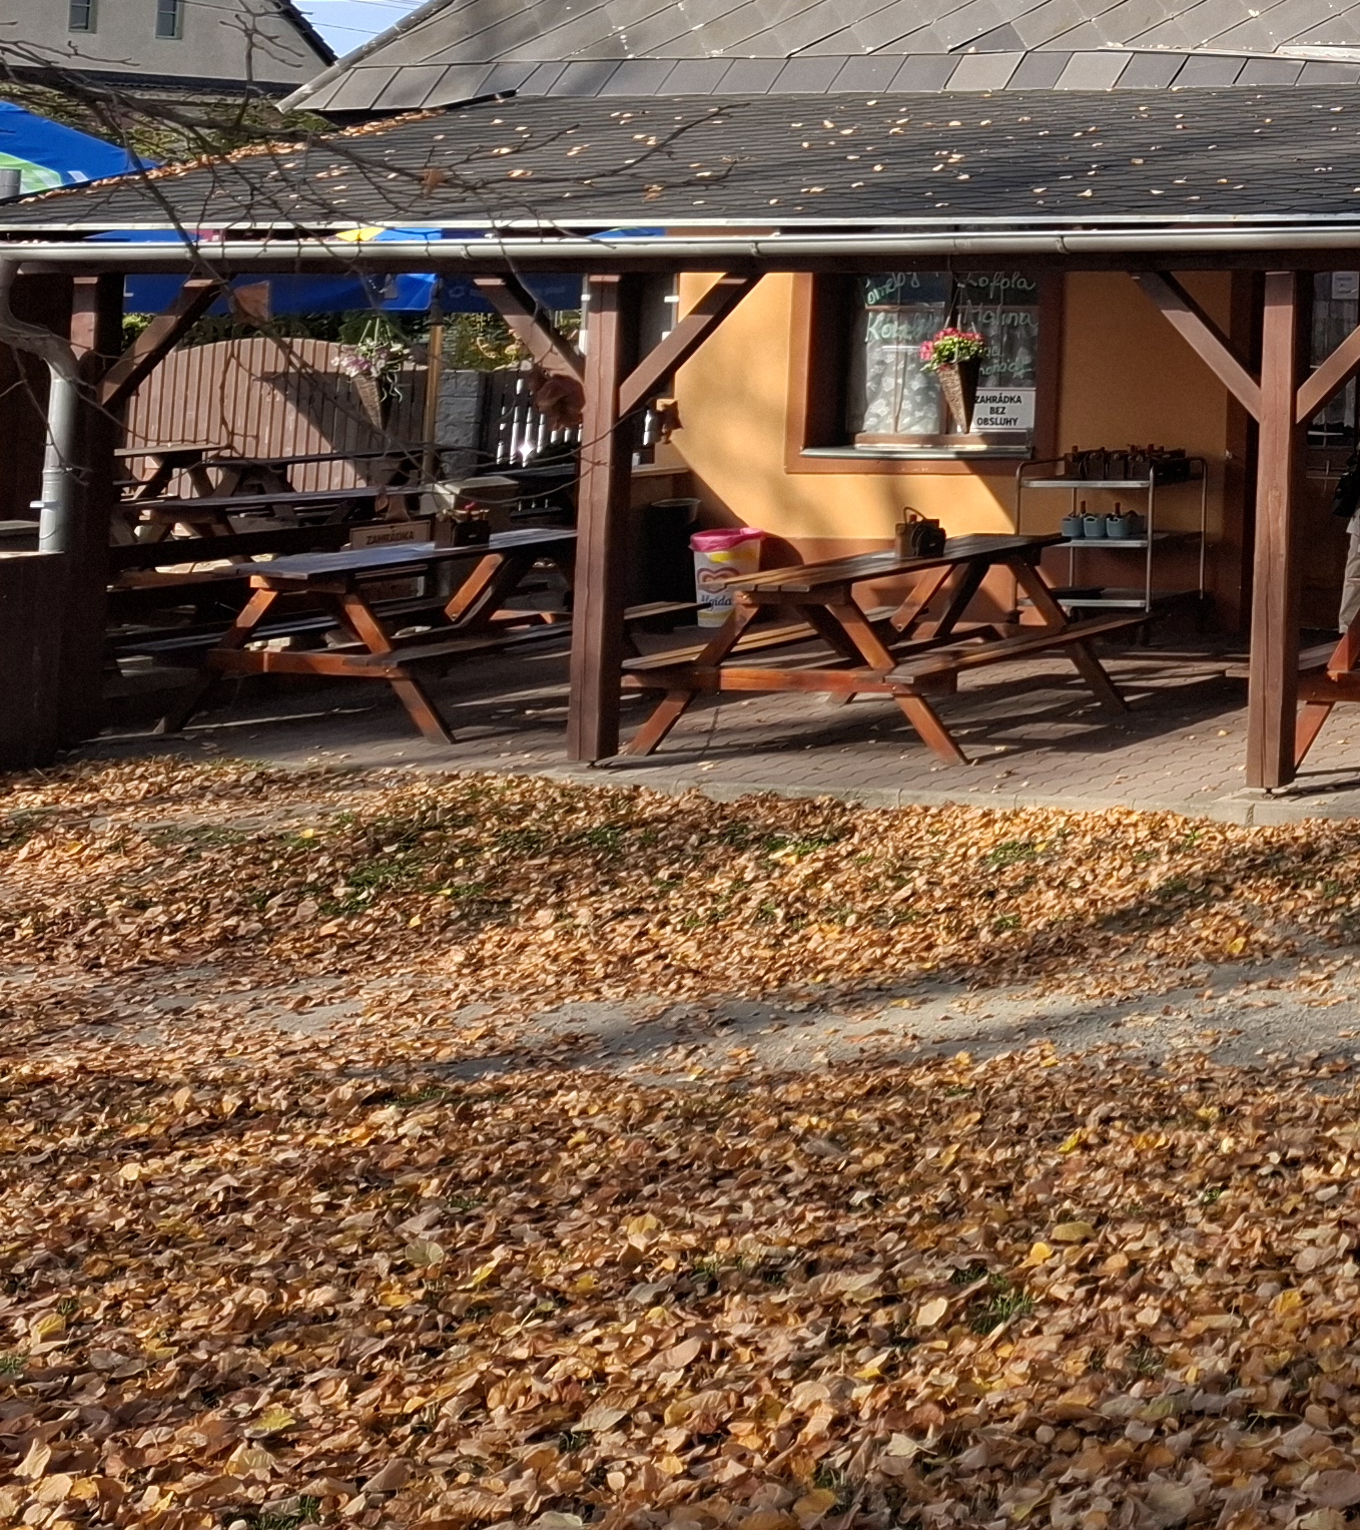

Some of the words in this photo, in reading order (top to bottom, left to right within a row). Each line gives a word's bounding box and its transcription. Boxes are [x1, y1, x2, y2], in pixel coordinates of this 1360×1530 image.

[963, 299, 1039, 327] Malina
[974, 392, 1022, 404] ZAHRÁDKA
[989, 406, 1006, 415] BEZ
[976, 417, 1019, 426] OBSLUHY
